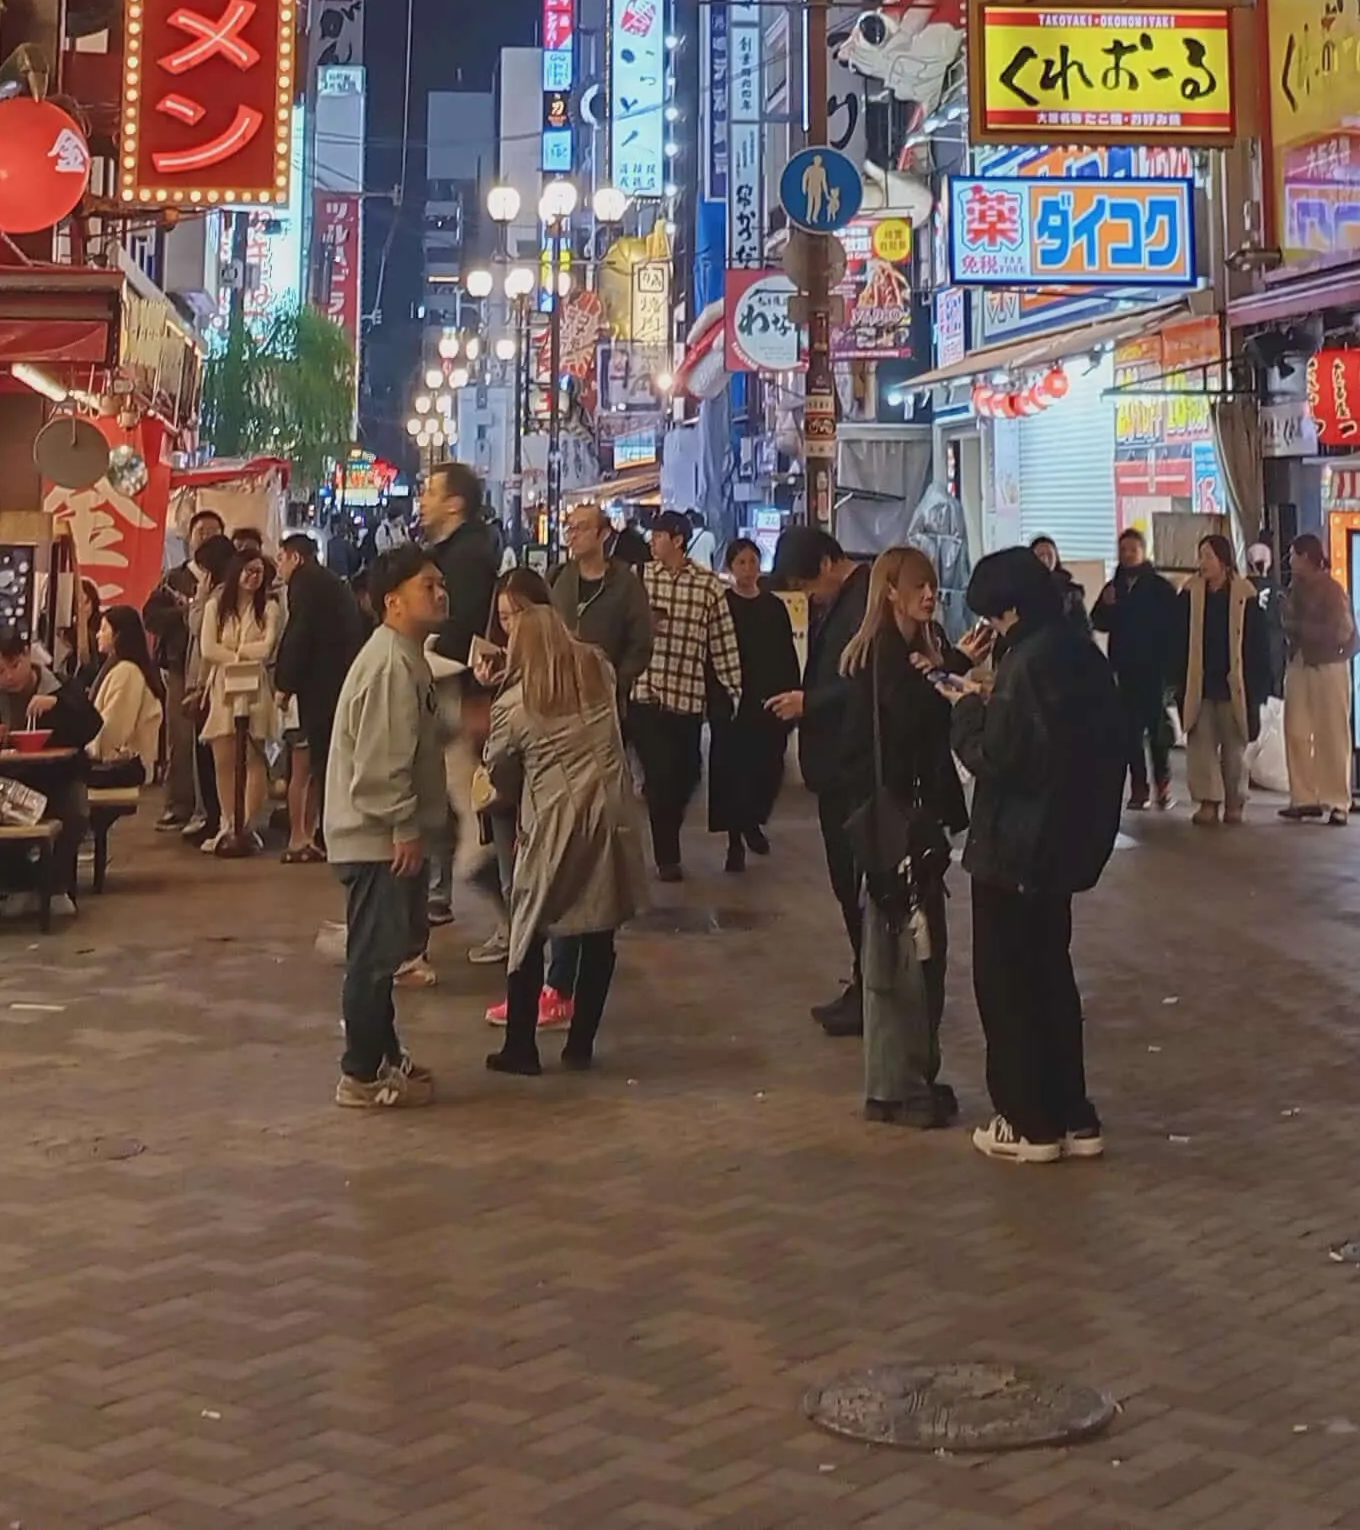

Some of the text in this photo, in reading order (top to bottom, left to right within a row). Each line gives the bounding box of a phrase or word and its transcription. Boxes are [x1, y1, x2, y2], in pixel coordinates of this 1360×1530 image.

[999, 32, 1217, 107] くれおーる
[48, 127, 88, 173] 金
[964, 184, 1179, 269] 薬 ダイコク
